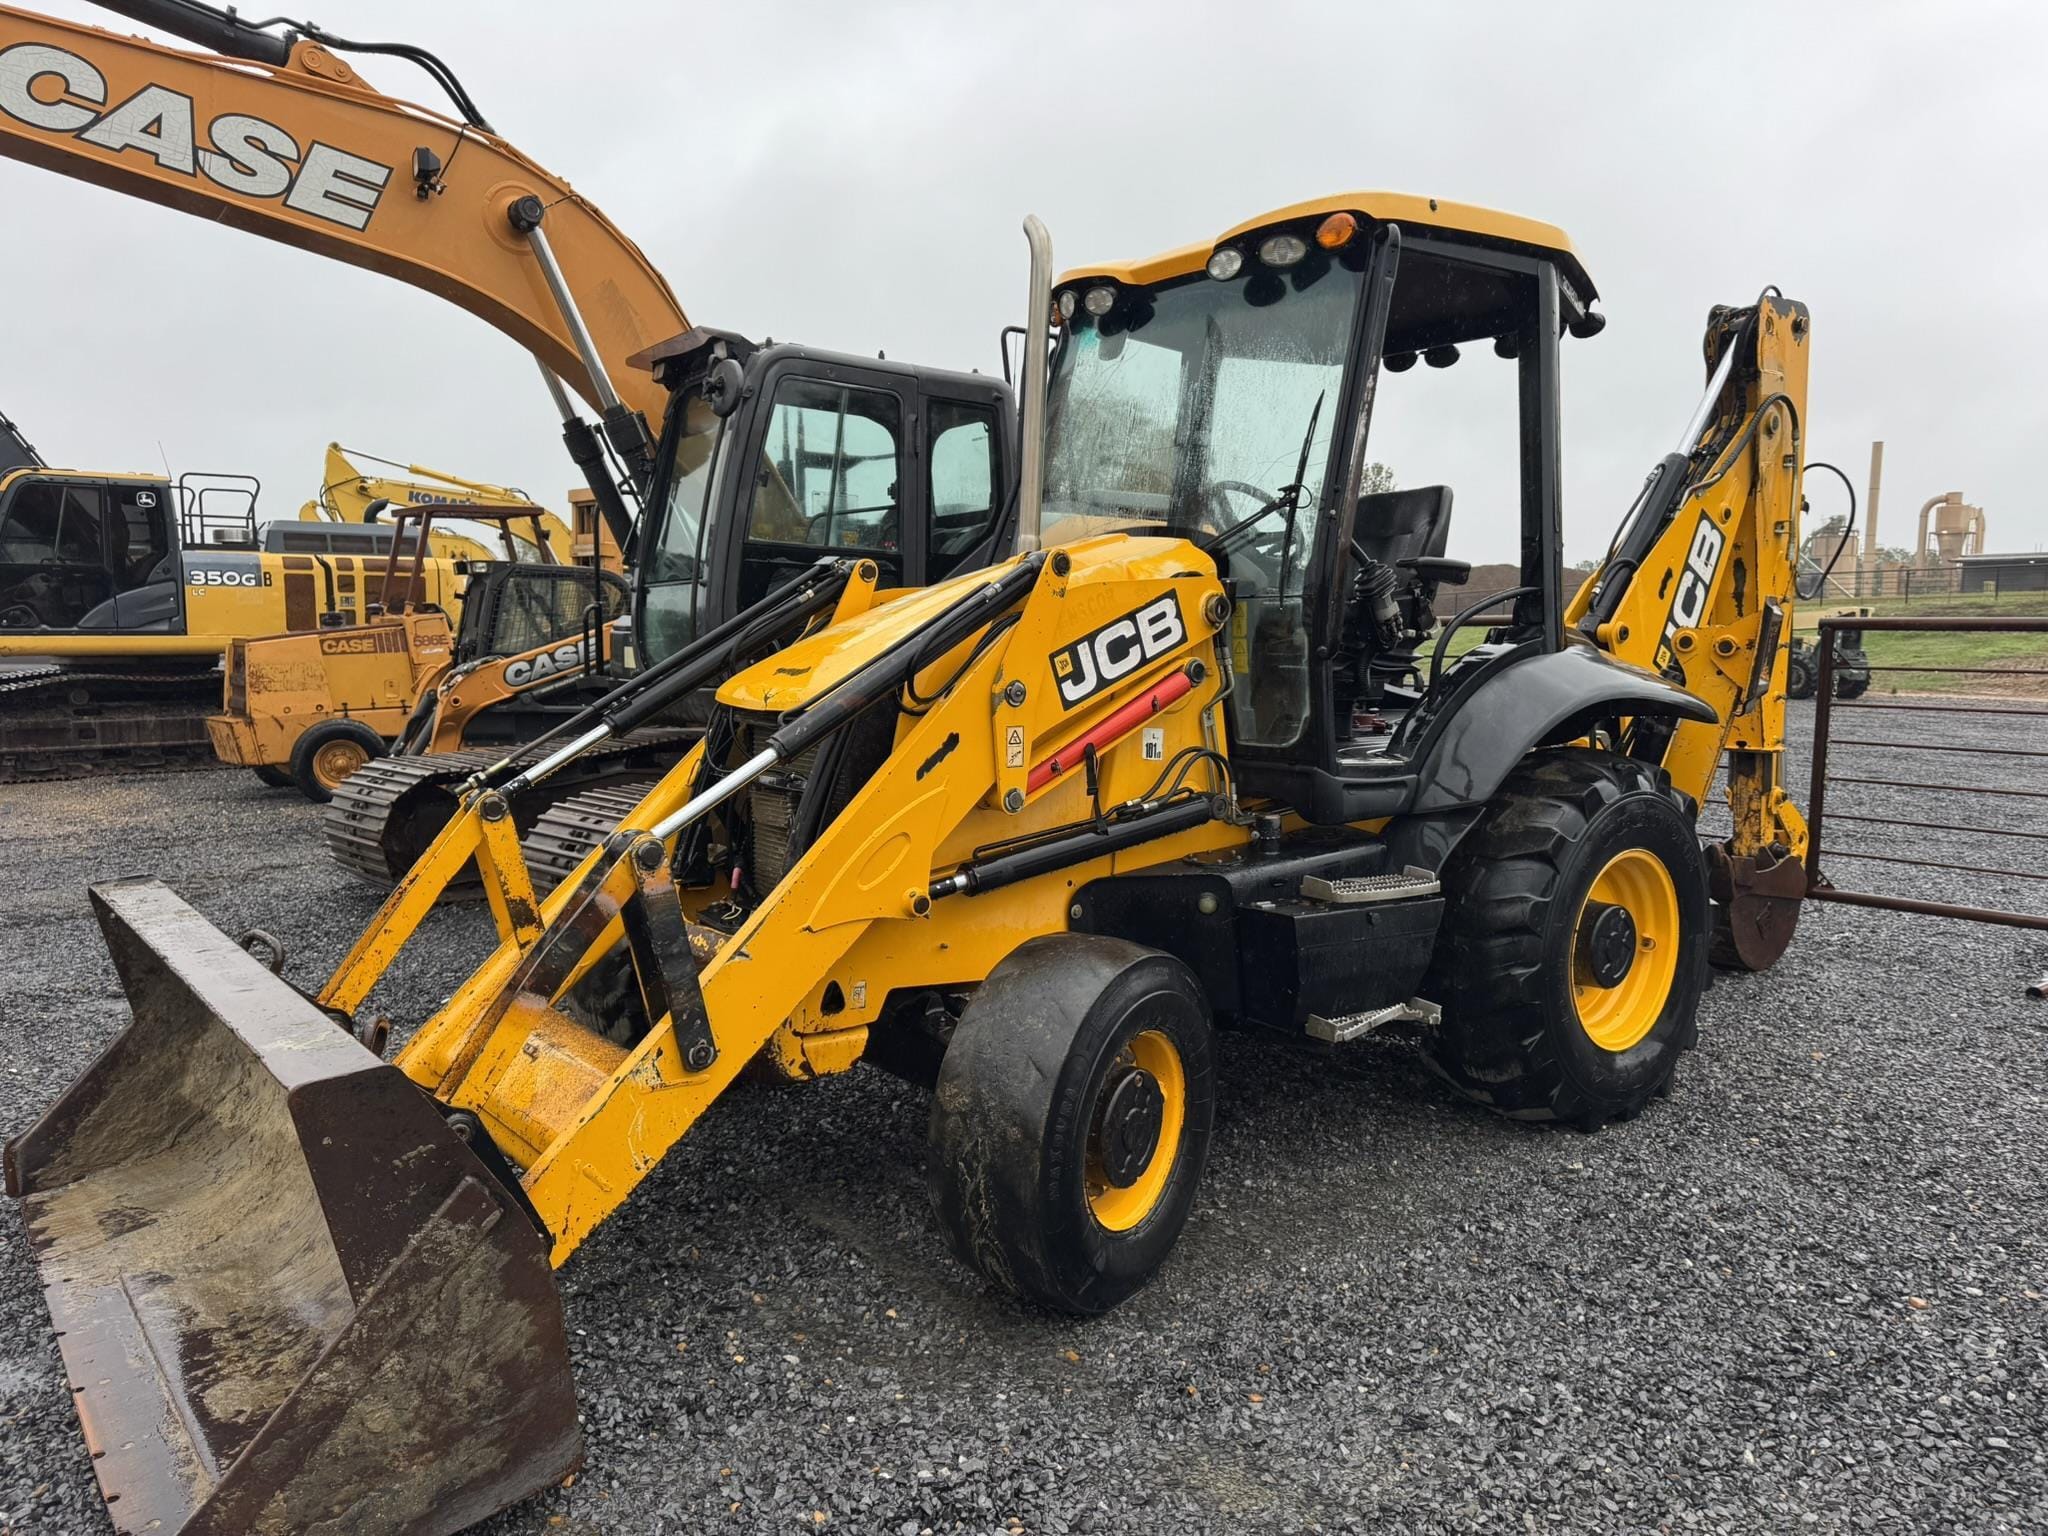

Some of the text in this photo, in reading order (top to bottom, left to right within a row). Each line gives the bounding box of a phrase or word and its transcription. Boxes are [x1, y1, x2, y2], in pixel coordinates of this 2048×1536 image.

[0, 42, 394, 232] CASE
[190, 570, 256, 586] 350G
[192, 588, 205, 596] LC
[1664, 519, 1722, 640] CB
[322, 638, 375, 653] CASE
[1060, 598, 1183, 701] JCB
